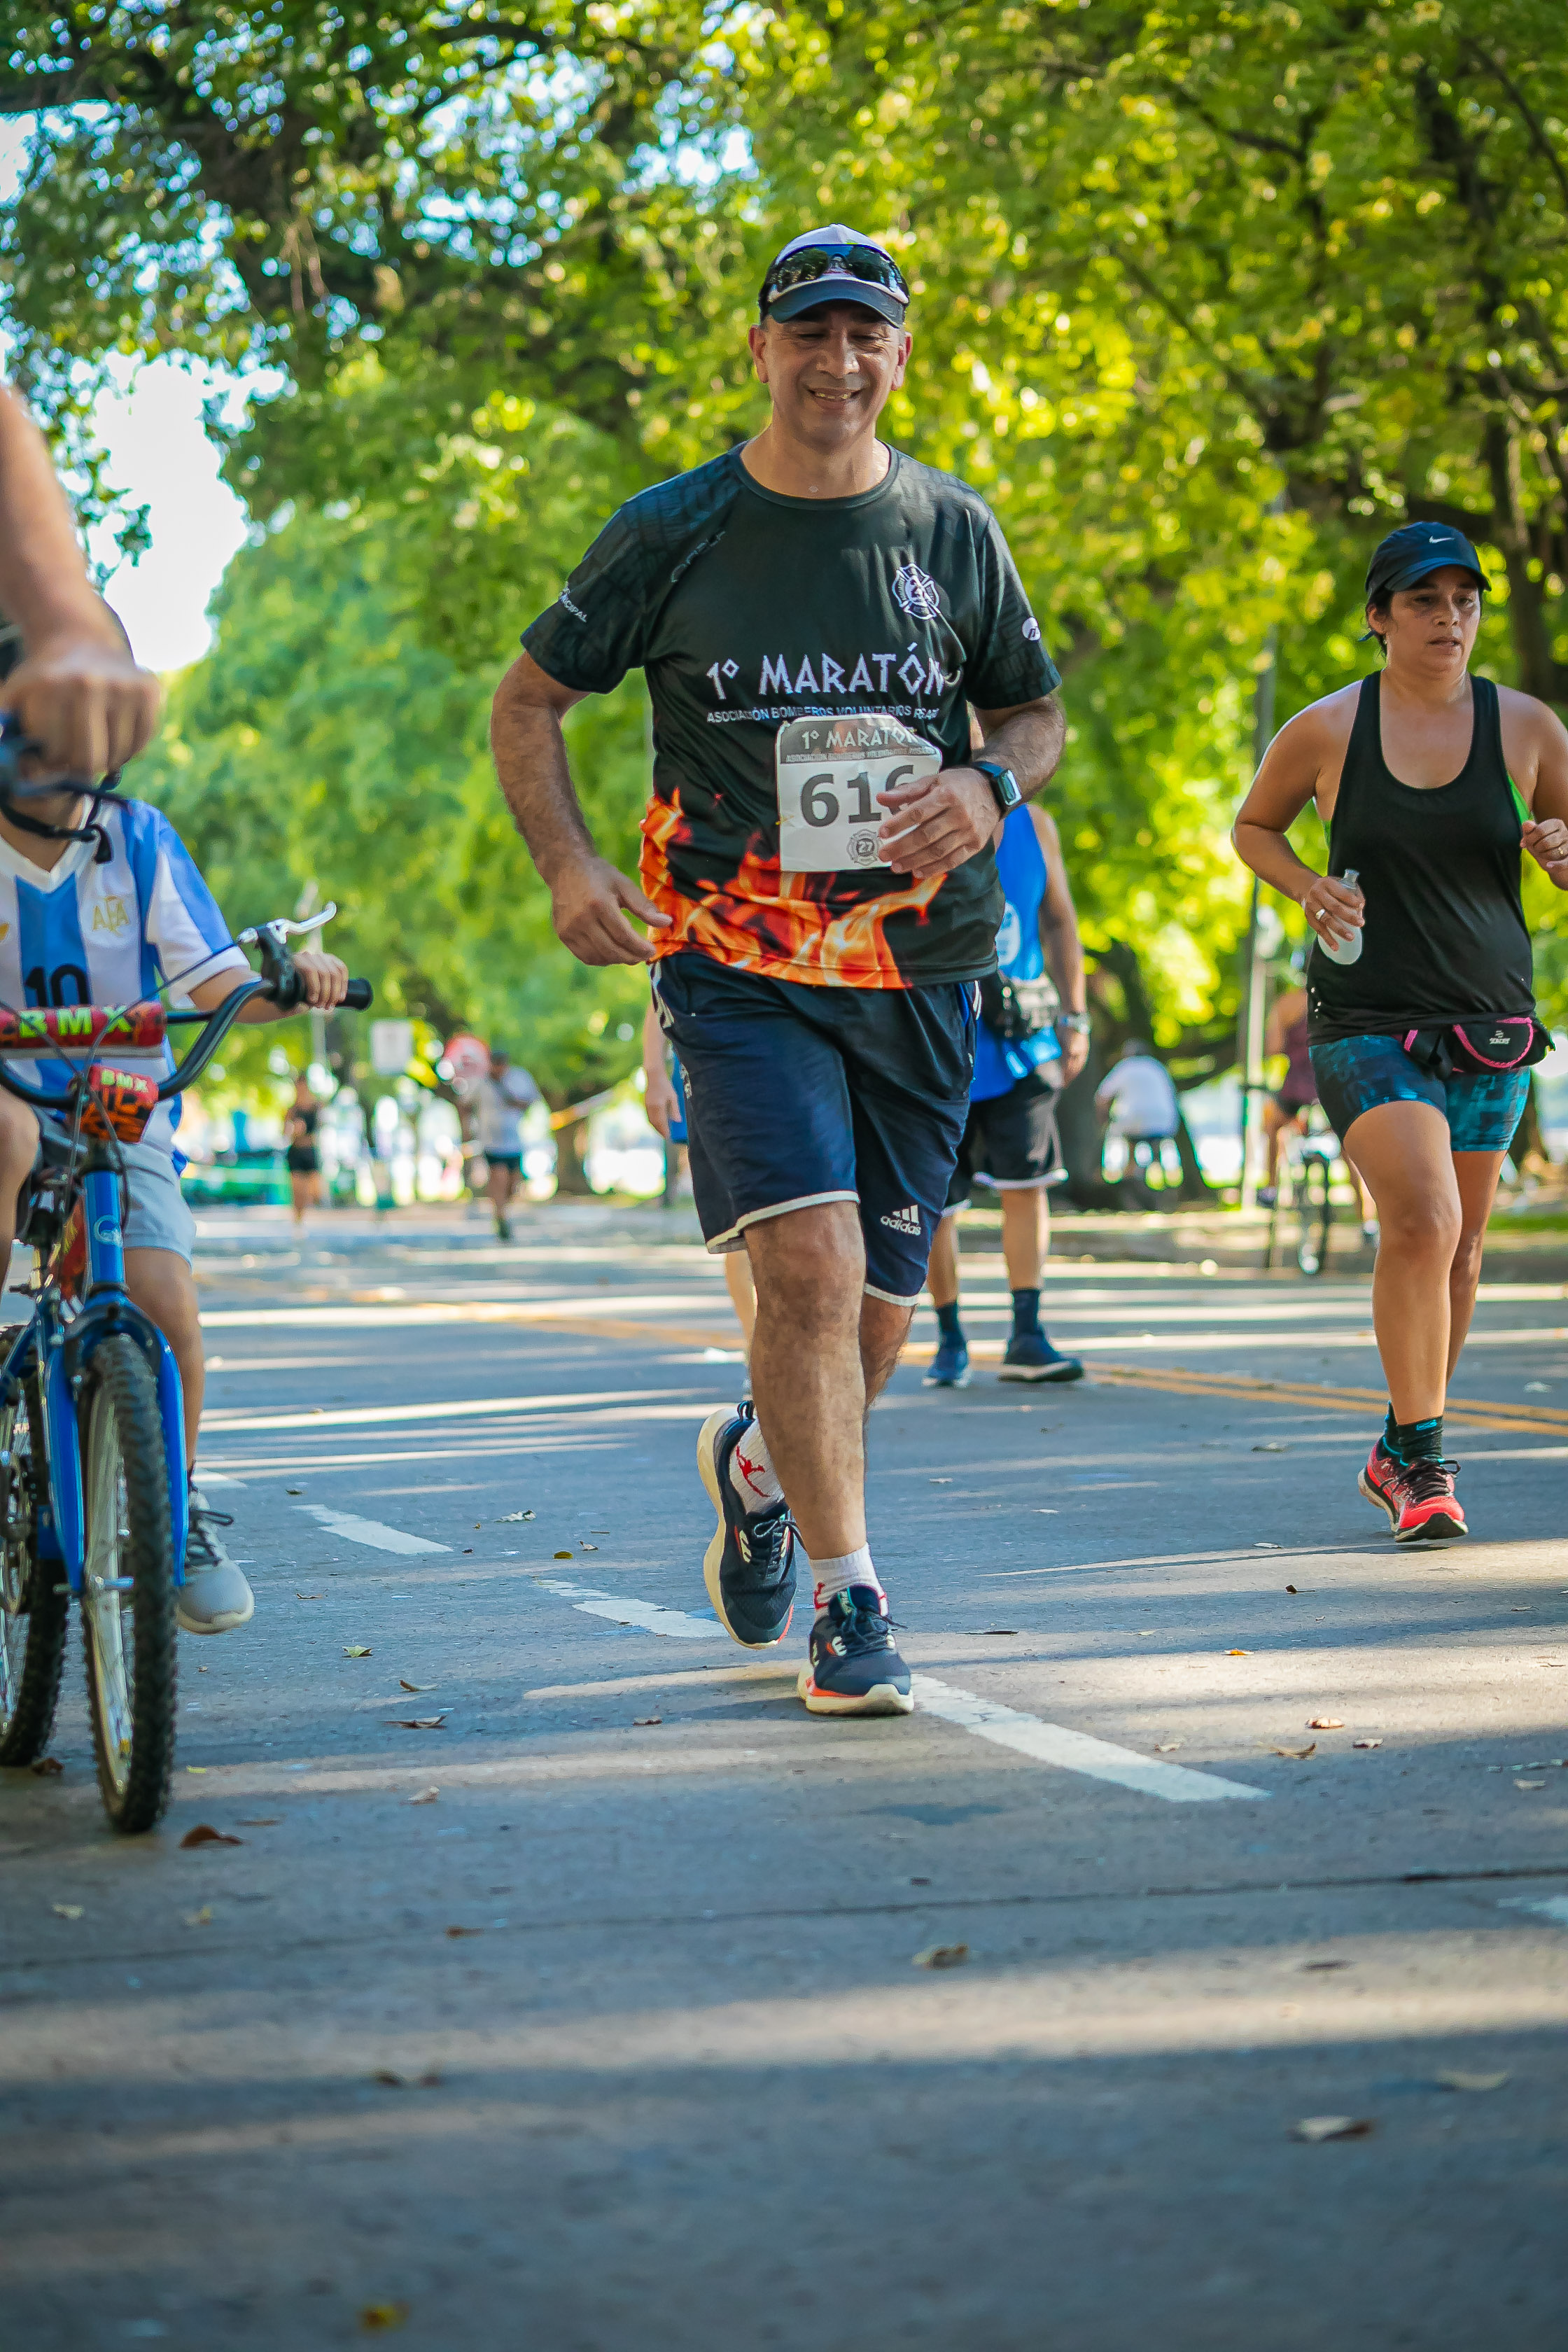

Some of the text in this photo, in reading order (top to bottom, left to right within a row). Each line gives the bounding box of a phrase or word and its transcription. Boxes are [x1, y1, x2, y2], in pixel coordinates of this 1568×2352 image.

[759, 642, 944, 696] MARATÓN
[858, 840, 874, 853] 27
[92, 896, 130, 937] AFA
[25, 963, 92, 1007] 10
[20, 1005, 132, 1037] BMX
[102, 1070, 149, 1093] BMX
[880, 1215, 922, 1236] adidas
